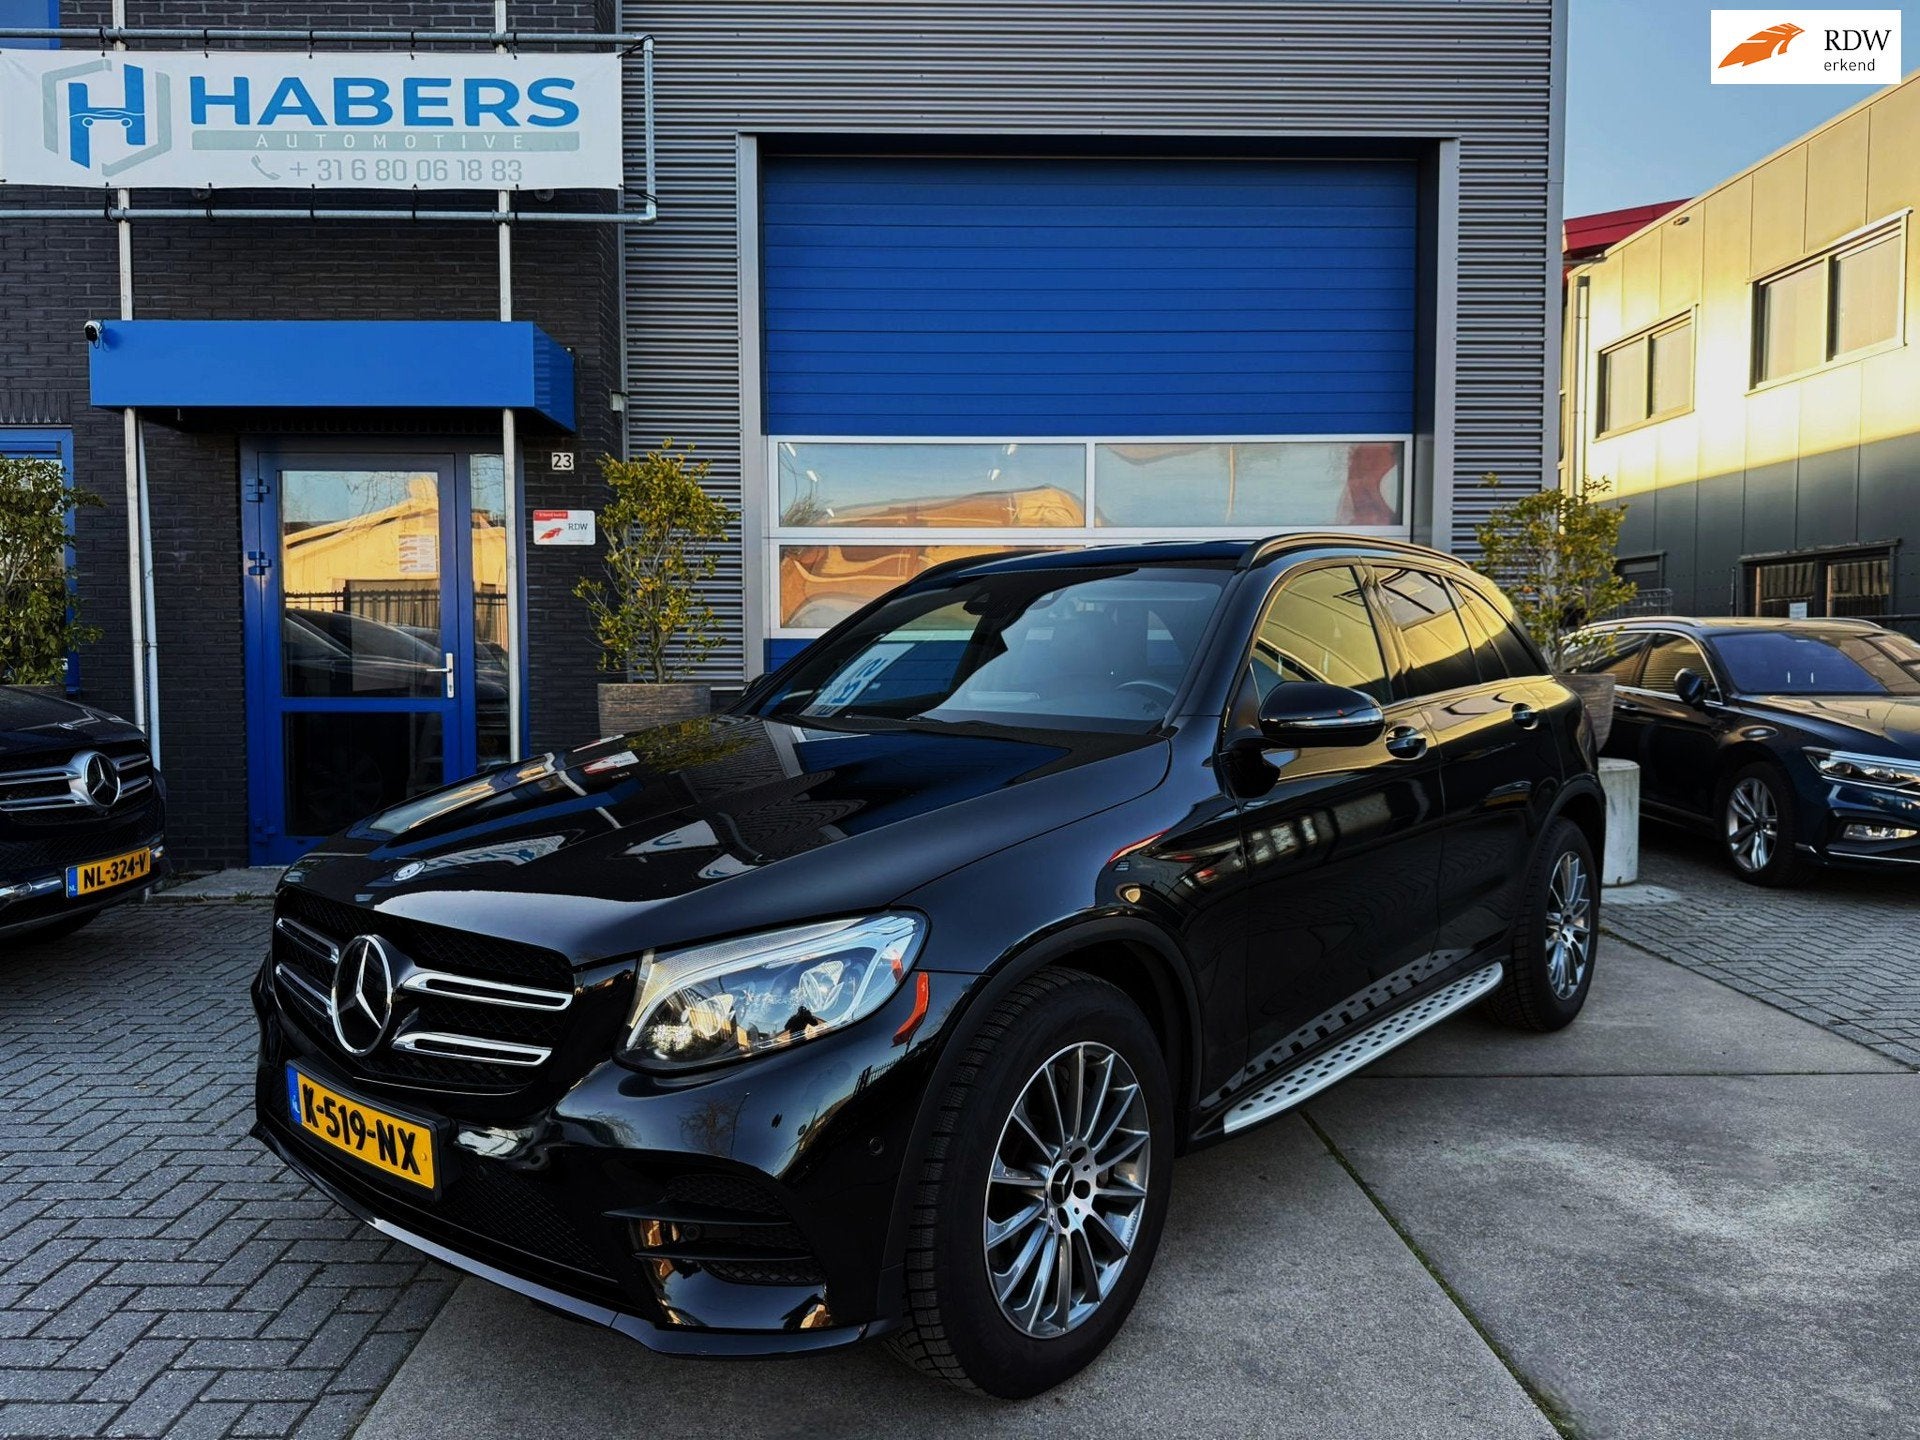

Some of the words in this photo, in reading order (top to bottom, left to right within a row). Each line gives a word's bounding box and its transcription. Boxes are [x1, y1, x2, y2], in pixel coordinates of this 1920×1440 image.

[189, 76, 580, 128] HABERS
[255, 133, 523, 149] AUTOMOTIVE
[317, 158, 343, 181] 31
[351, 159, 367, 181] 6
[375, 159, 407, 182] 80
[416, 159, 448, 182] 06
[456, 159, 483, 182] 18
[491, 159, 523, 182] 83
[553, 454, 572, 468] 23
[83, 852, 147, 890] NL-324-V
[302, 1083, 421, 1175] K-519-NX
